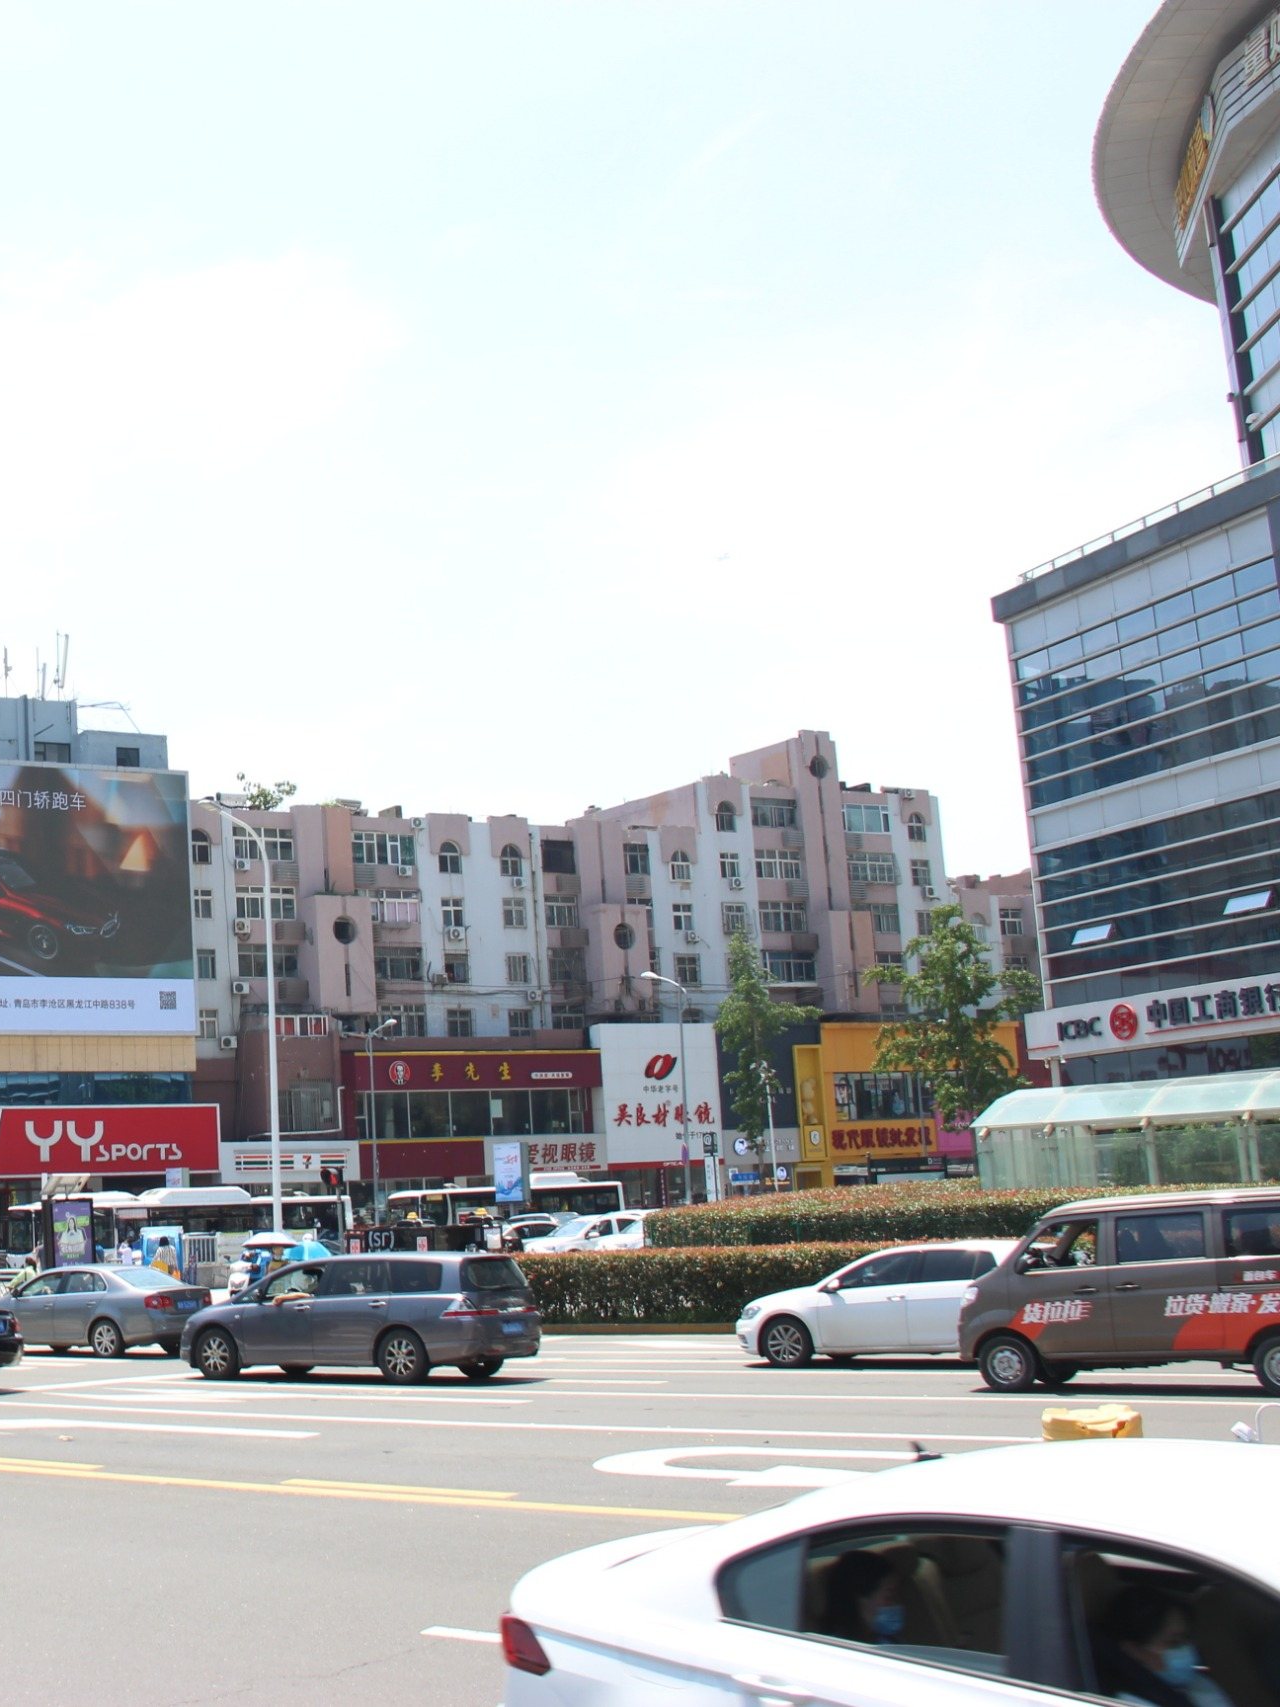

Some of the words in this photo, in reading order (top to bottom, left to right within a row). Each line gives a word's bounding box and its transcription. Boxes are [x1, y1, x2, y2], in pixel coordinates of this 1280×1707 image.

[1056, 1016, 1102, 1042] ICBC
[431, 1061, 511, 1082] 李先生
[642, 1083, 679, 1093] 中华老字号
[1021, 1300, 1087, 1324] 货拉拉
